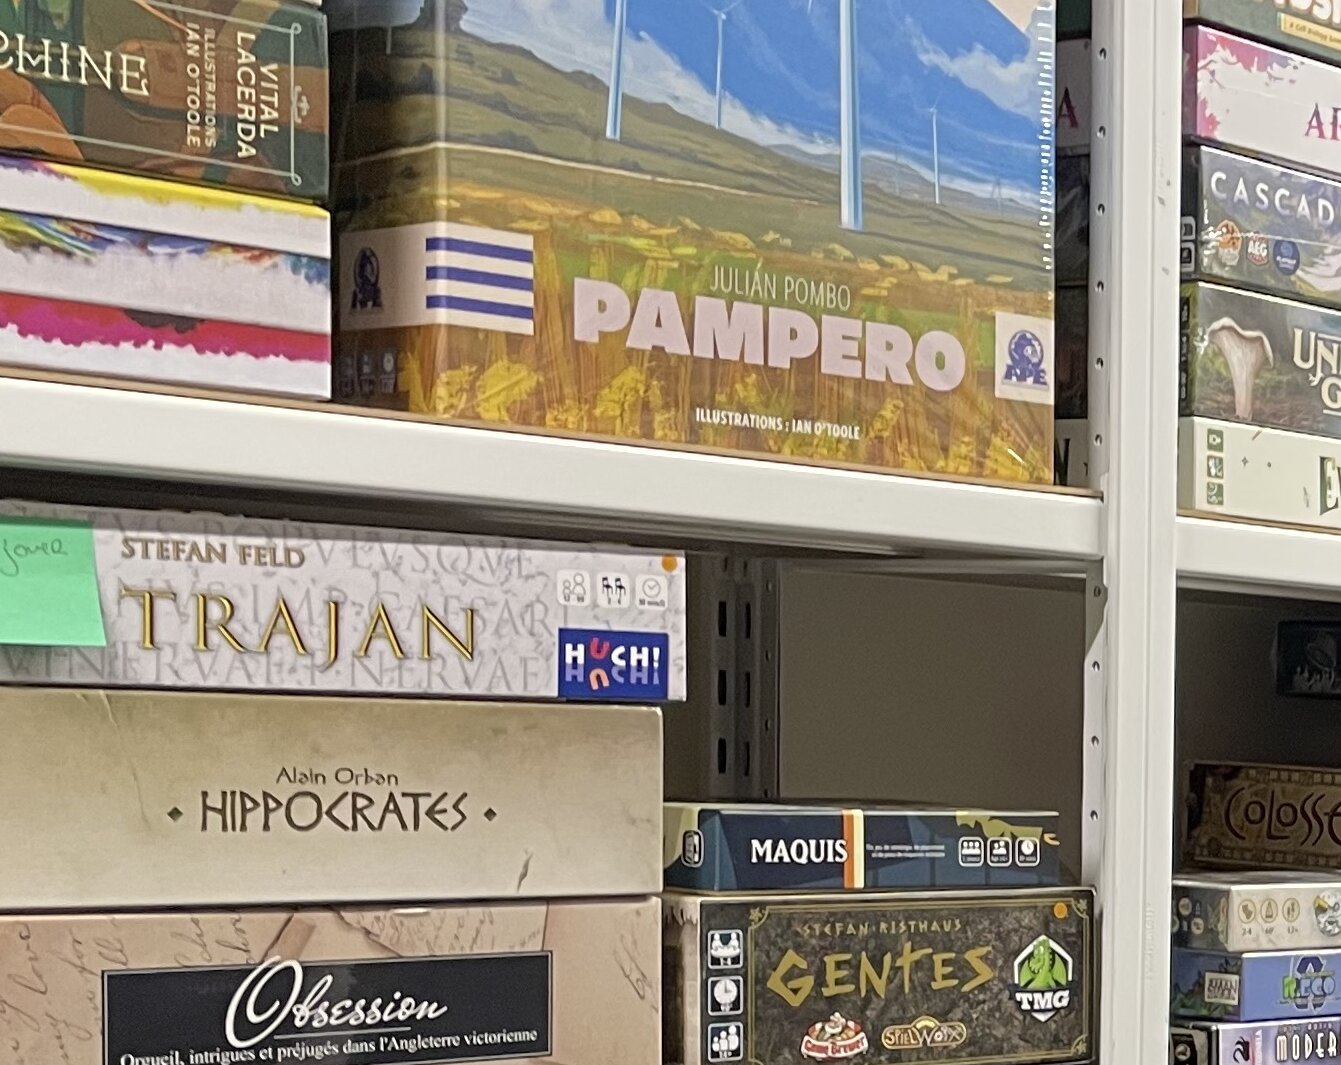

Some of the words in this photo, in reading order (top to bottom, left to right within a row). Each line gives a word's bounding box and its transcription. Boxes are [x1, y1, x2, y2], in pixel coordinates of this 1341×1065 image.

[186, 22, 200, 57] IAN
[186, 64, 201, 147] O'TOOLE
[204, 27, 216, 148] ILLUSTRATIONS
[237, 31, 256, 158] LACERDA
[259, 62, 279, 139] VITAL
[1247, 239, 1268, 257] AEG
[710, 257, 777, 300] JULIÁN
[784, 275, 851, 311] POMBO
[573, 276, 966, 392] PAMPERO
[695, 407, 783, 432] ILLUSTRATIONS
[791, 419, 813, 436] IAN
[813, 421, 860, 441] O'TOOLE
[121, 537, 227, 564] STEFAN
[238, 545, 305, 568] FELD
[118, 585, 476, 672] TRAJAN
[276, 766, 327, 786] Alain
[335, 768, 399, 786] Orban
[200, 790, 467, 832] HIPPOCRATES
[750, 838, 849, 865] MAQUIS
[802, 920, 869, 938] STEFAN
[878, 917, 963, 935] RISTHAUS
[767, 941, 995, 1007] GENTES
[224, 955, 448, 1049] Obsession
[1015, 988, 1070, 1012] TMG
[259, 1044, 272, 1063] et
[277, 1036, 339, 1063] préjugés
[342, 1036, 376, 1055] dans
[378, 1031, 460, 1055] l'Angleterre
[464, 1027, 538, 1047] victorienne
